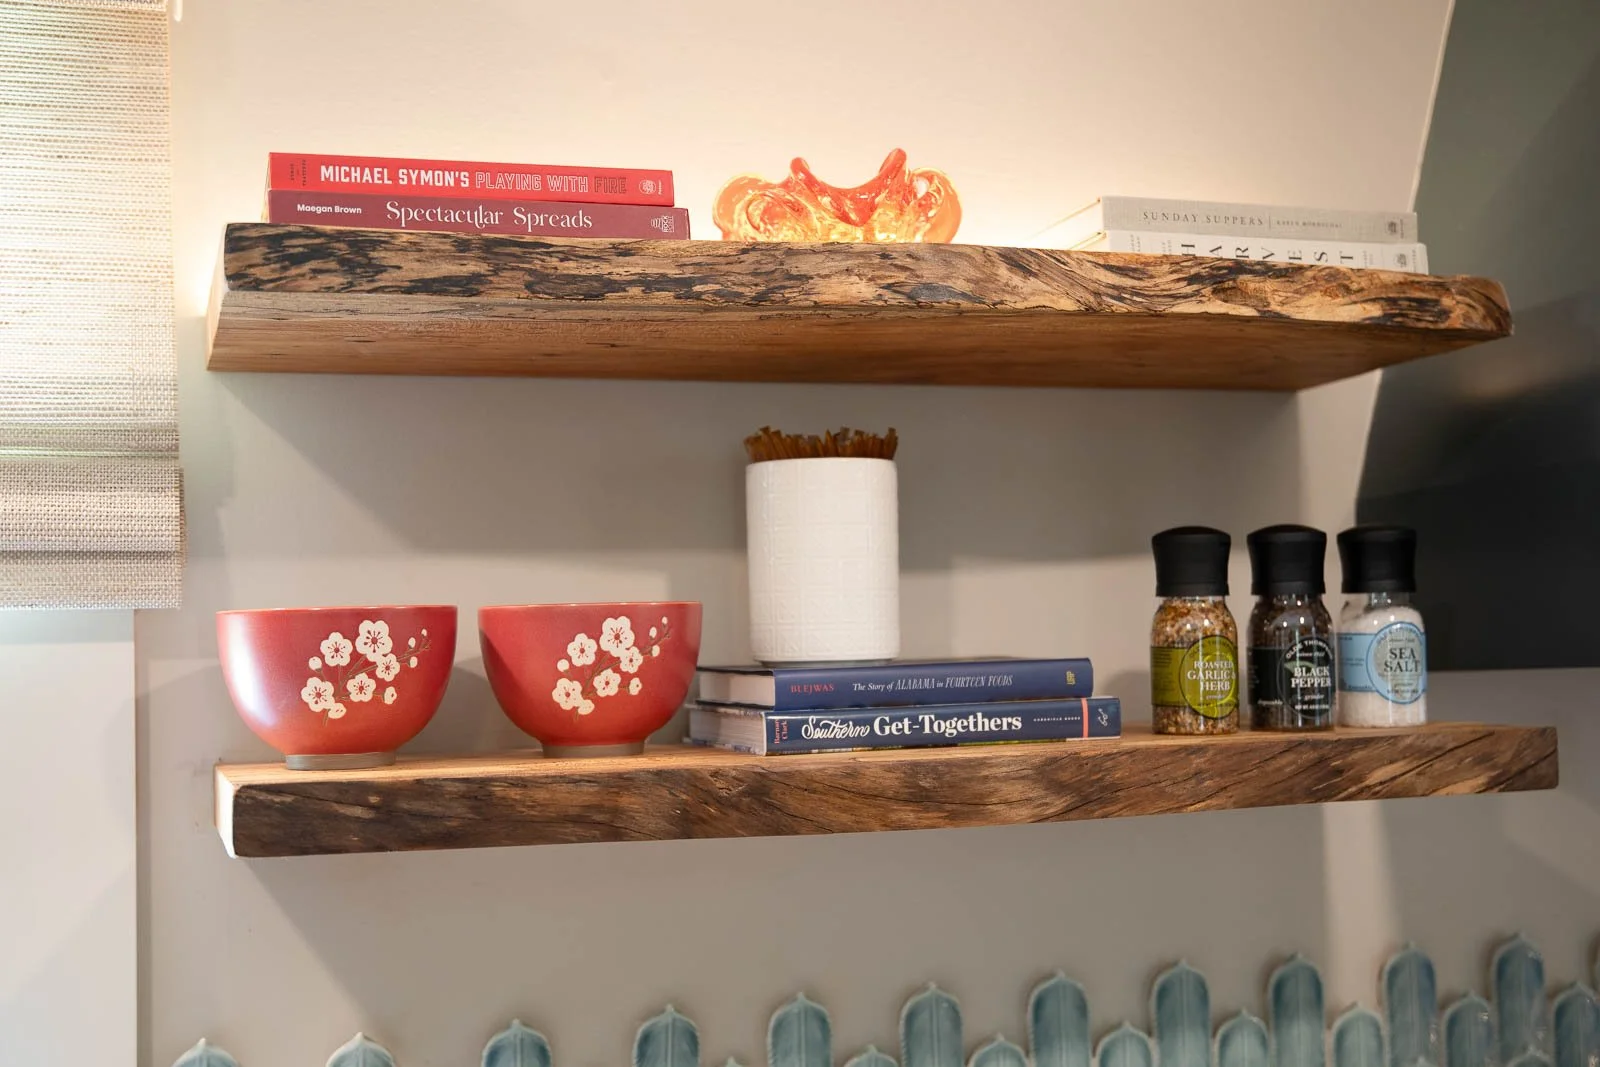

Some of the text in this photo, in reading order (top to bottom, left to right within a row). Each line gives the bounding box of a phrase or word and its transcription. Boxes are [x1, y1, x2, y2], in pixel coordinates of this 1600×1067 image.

[320, 165, 628, 194] MICHAEL SYMON'S PLAYING WITH FIRE
[296, 204, 363, 215] Maegan Brown
[386, 200, 593, 232] Spectacular Spreads
[1142, 211, 1265, 227] SUNDAY SUPPERS
[1389, 648, 1417, 660] SEA
[1194, 660, 1234, 669] ROASTED
[1383, 660, 1421, 673] SALT
[1187, 669, 1231, 680] GARLIC
[1294, 666, 1330, 677] BLACK
[852, 674, 1014, 693] The Story of ALABAMA in FOURTEEN FOODS
[1200, 680, 1231, 691] HERB
[1290, 677, 1332, 688] PEPPER
[801, 711, 1023, 740] Southern Get-Togethers
